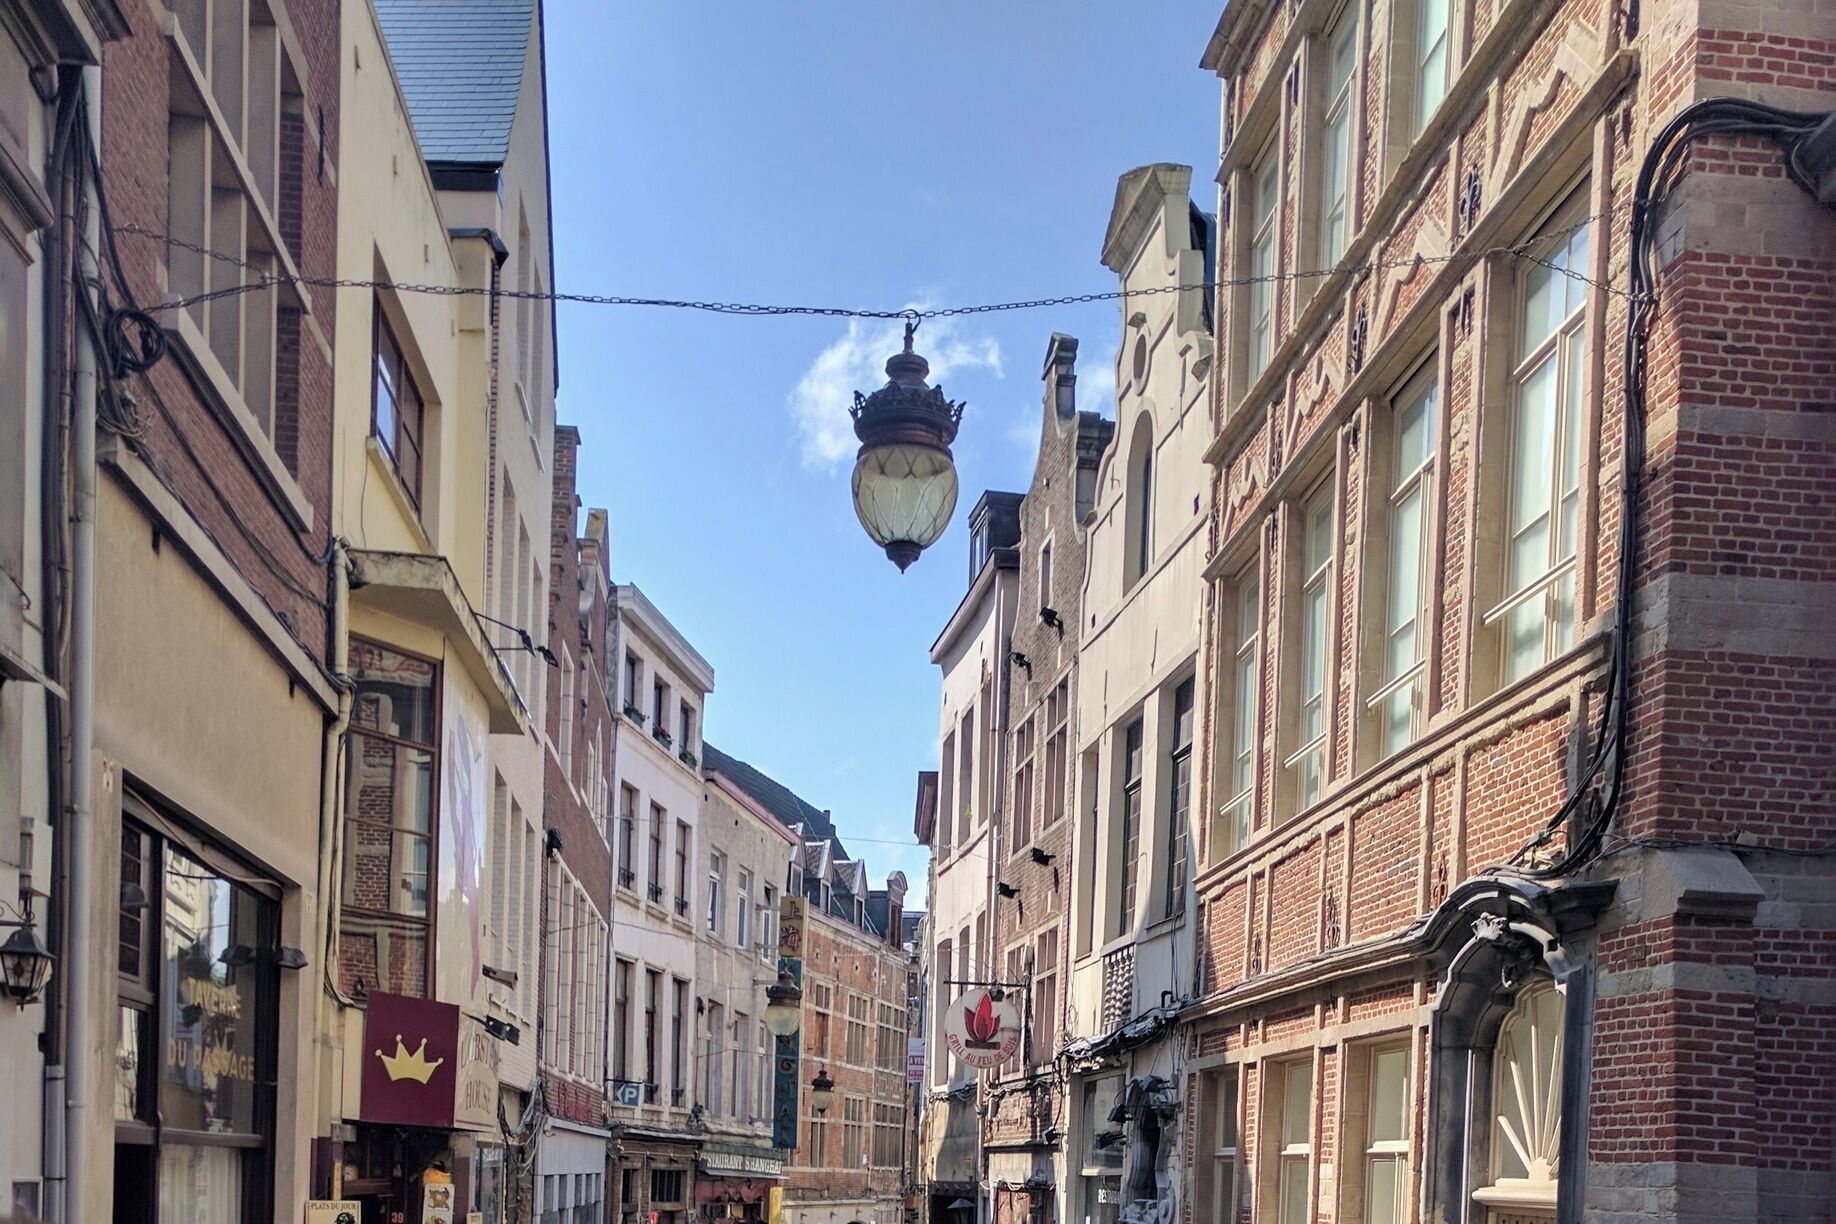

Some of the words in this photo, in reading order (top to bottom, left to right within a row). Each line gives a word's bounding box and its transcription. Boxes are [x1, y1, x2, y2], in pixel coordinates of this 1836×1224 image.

[780, 901, 803, 951] 上海
[167, 1037, 187, 1068] DU
[949, 1033, 965, 1057] GRILL
[965, 1053, 976, 1064] AU
[978, 1056, 992, 1065] FEU
[993, 1051, 1004, 1063] DE
[1002, 1036, 1017, 1055] BOIS
[466, 1080, 491, 1114] HOUSE
[625, 1087, 637, 1103] P
[745, 1156, 782, 1174] SHANGHAI
[341, 1203, 356, 1211] JOUR
[391, 1212, 404, 1223] 39
